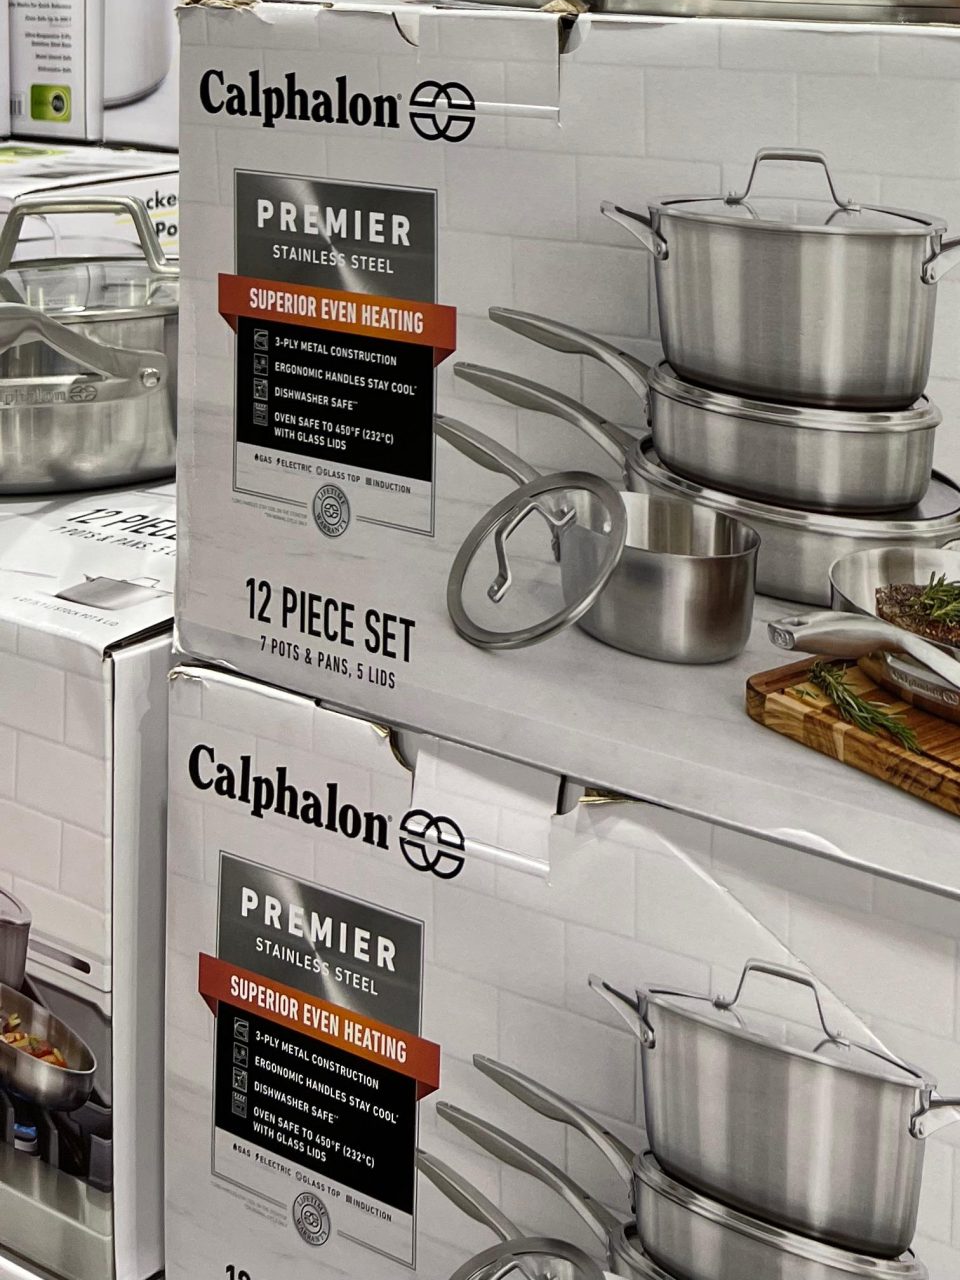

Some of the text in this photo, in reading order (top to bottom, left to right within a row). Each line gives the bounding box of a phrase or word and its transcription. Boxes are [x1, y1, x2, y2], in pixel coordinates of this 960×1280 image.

[200, 69, 400, 128] Calphalon
[257, 198, 411, 247] PREMIER
[272, 244, 394, 274] STAINLESS STEEL
[250, 287, 424, 334] SUPERIOR EVEN HEATING
[275, 336, 397, 366] 3-PLY METAL CONSTRUCTION
[274, 361, 323, 379] ERGONOMIC
[325, 371, 365, 387] HANDLES
[367, 378, 389, 391] STAY
[274, 386, 329, 406] DISHWASHER
[274, 411, 394, 445] OVEN SAFE TO 450°F (232°C)
[274, 426, 347, 450] WITH GLASS LIDS
[259, 454, 411, 494] GAS ELECTRIC GLASS TOP INDUCTION
[318, 488, 346, 504] LIFETIME
[66, 508, 123, 523] 12
[316, 512, 347, 534] WARRANTY
[246, 577, 416, 663] 12 PIECE SET
[260, 635, 396, 689] 7 POTS & PANS, 5 LIDS
[188, 744, 389, 850] Calphalon
[240, 886, 396, 971] PREMIER
[255, 937, 378, 996] STAINLESS STEEL
[230, 975, 407, 1063] SUPERIOR EVEN HEATING
[255, 1030, 379, 1090] 3-PLY METAL CONSTRUCTION
[254, 1056, 304, 1084] ERGONOMIC
[306, 1077, 347, 1103] HANDLES
[349, 1096, 371, 1113] STAY
[254, 1080, 309, 1113] DISHWASHER
[253, 1106, 375, 1168] OVEN SAFE TO 450°F (232°C)
[253, 1120, 327, 1162] WITH GLASS LIDS
[237, 1145, 392, 1222] GAS ELECTRIC GLASS TOP INDUCTION
